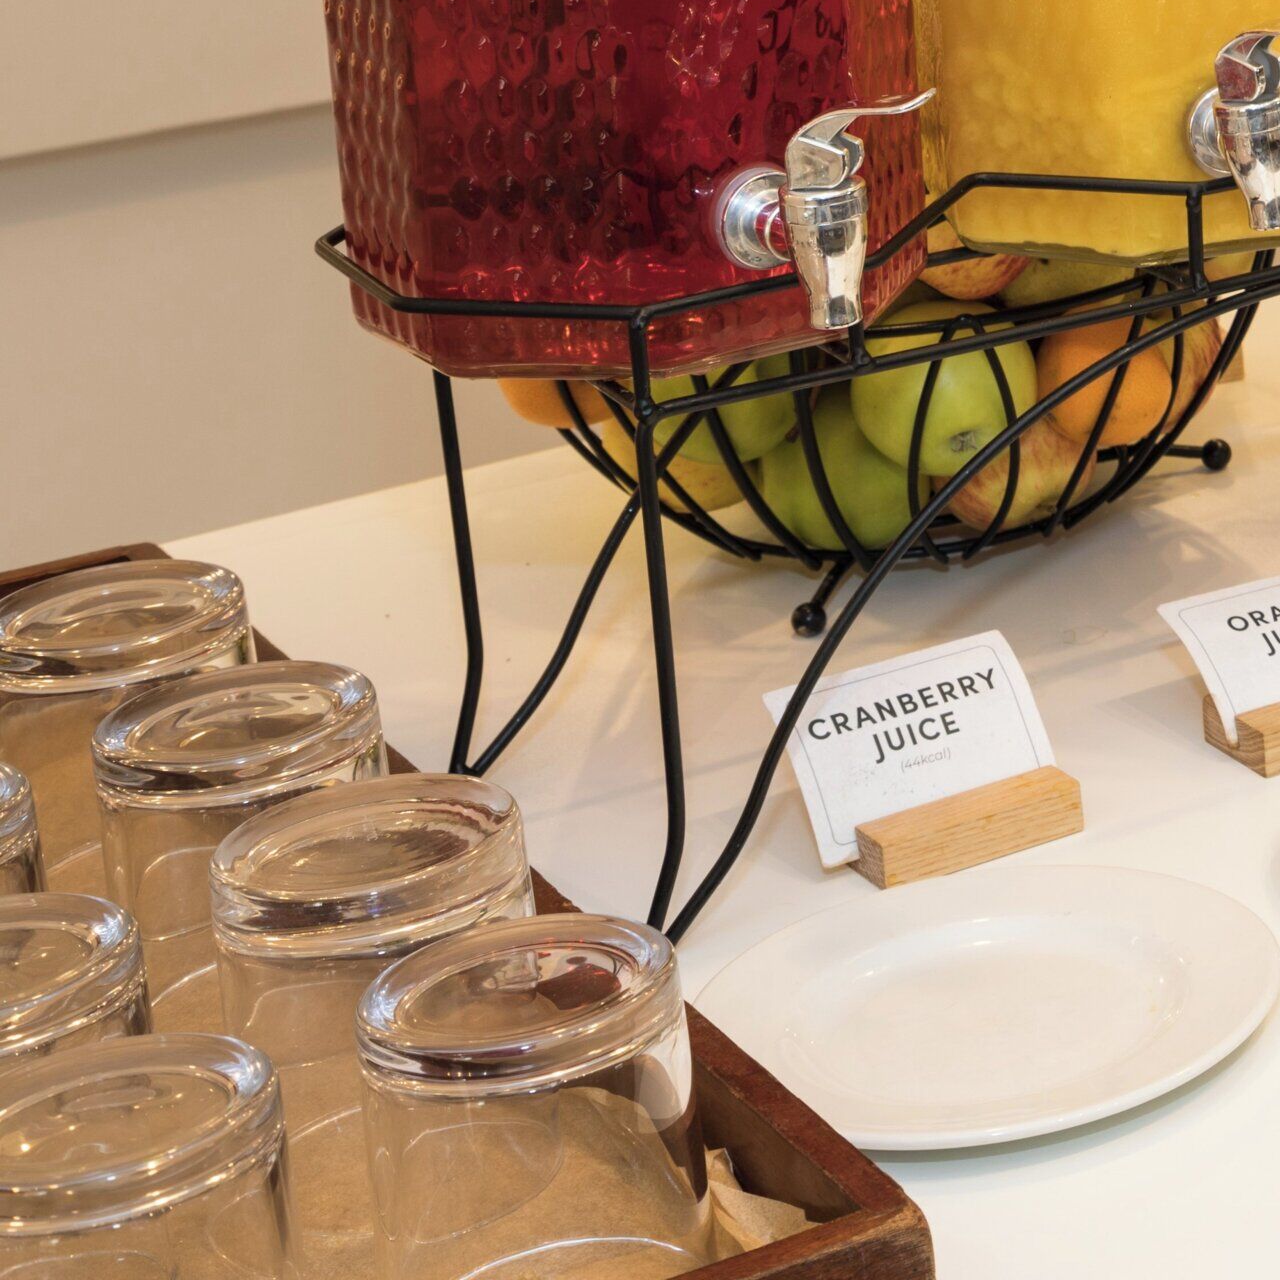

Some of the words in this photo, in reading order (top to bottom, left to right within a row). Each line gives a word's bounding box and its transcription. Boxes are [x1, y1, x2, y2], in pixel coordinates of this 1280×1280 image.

[807, 668, 995, 739] CRANBERRY
[872, 711, 960, 764] JUICE
[900, 748, 950, 772] (44kcal)
